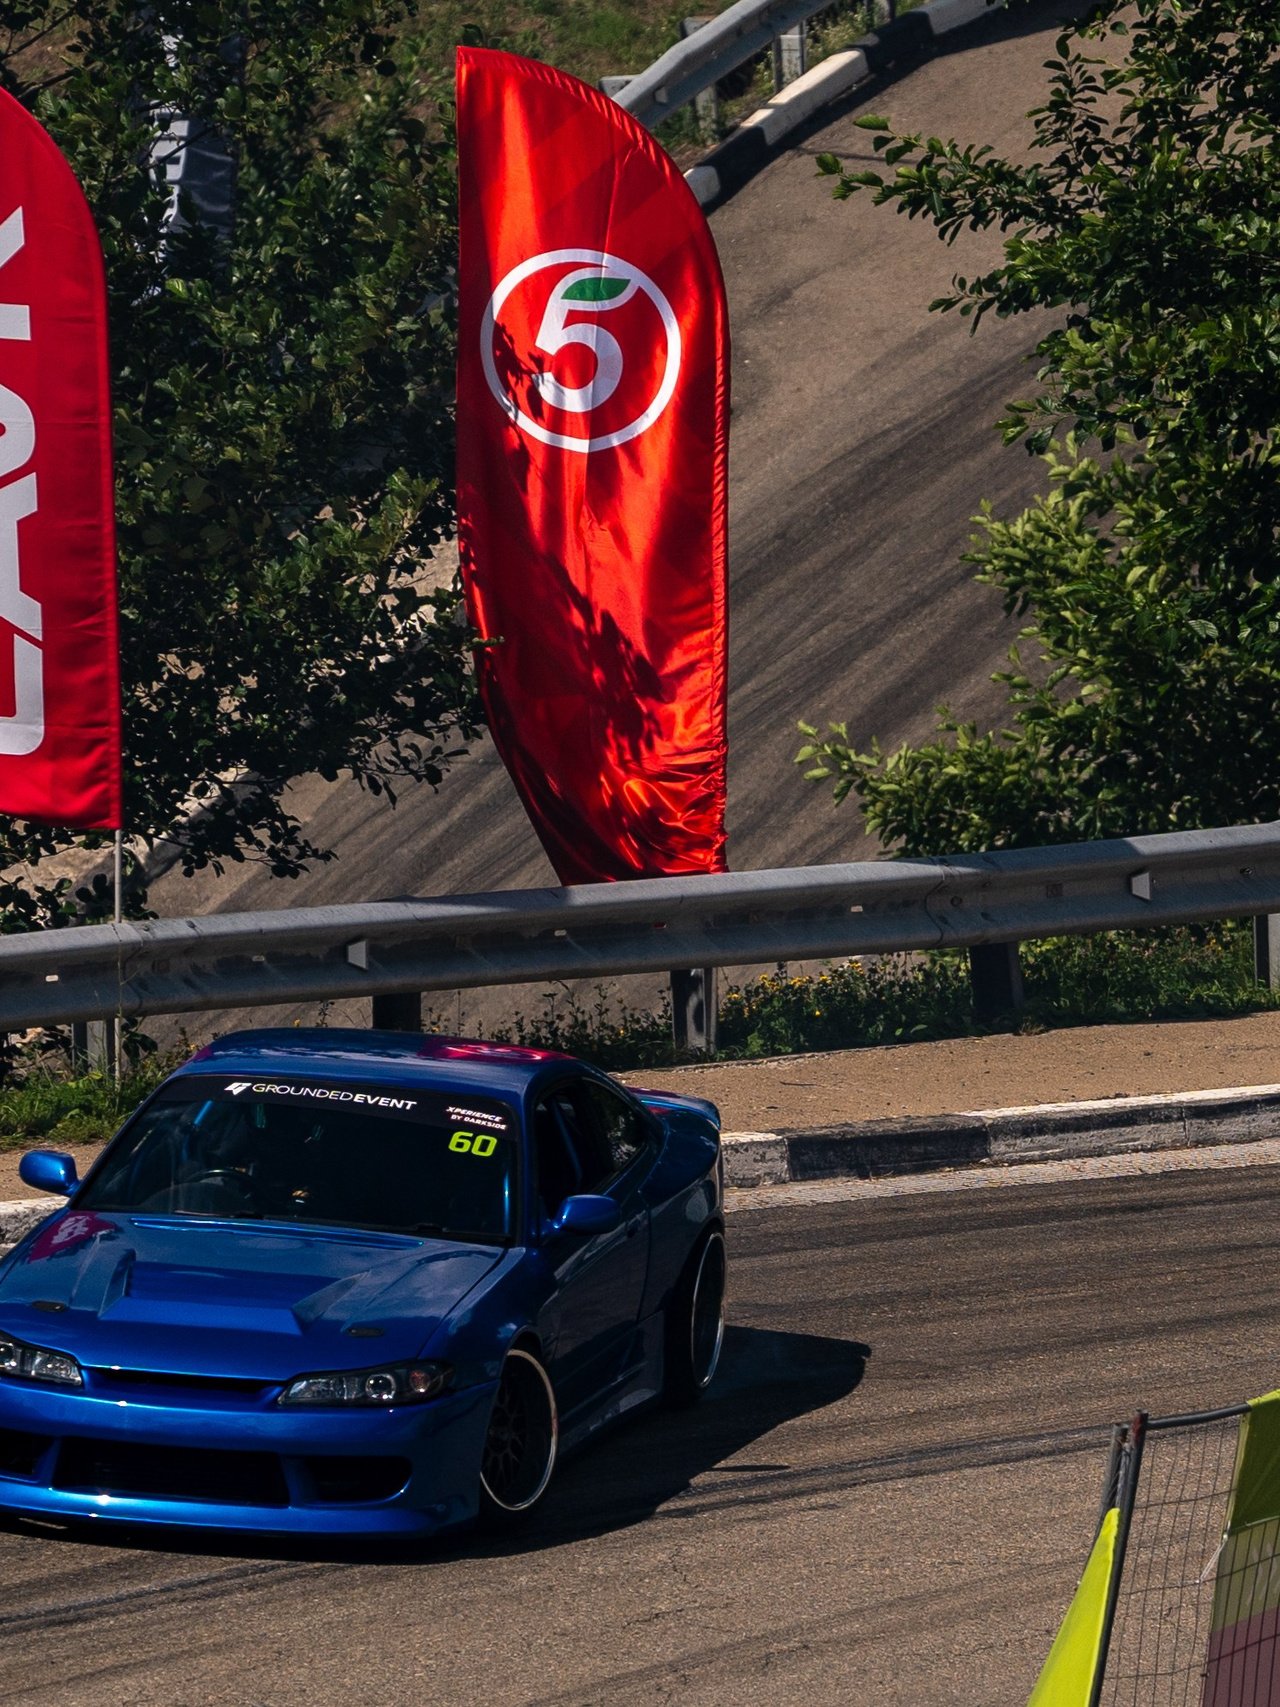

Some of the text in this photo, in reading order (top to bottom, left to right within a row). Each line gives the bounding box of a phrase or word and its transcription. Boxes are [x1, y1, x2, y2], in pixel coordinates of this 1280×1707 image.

[446, 1106, 502, 1121] XPERIENCE
[464, 1116, 507, 1129] DARKSIDE
[448, 1131, 497, 1156] 60
